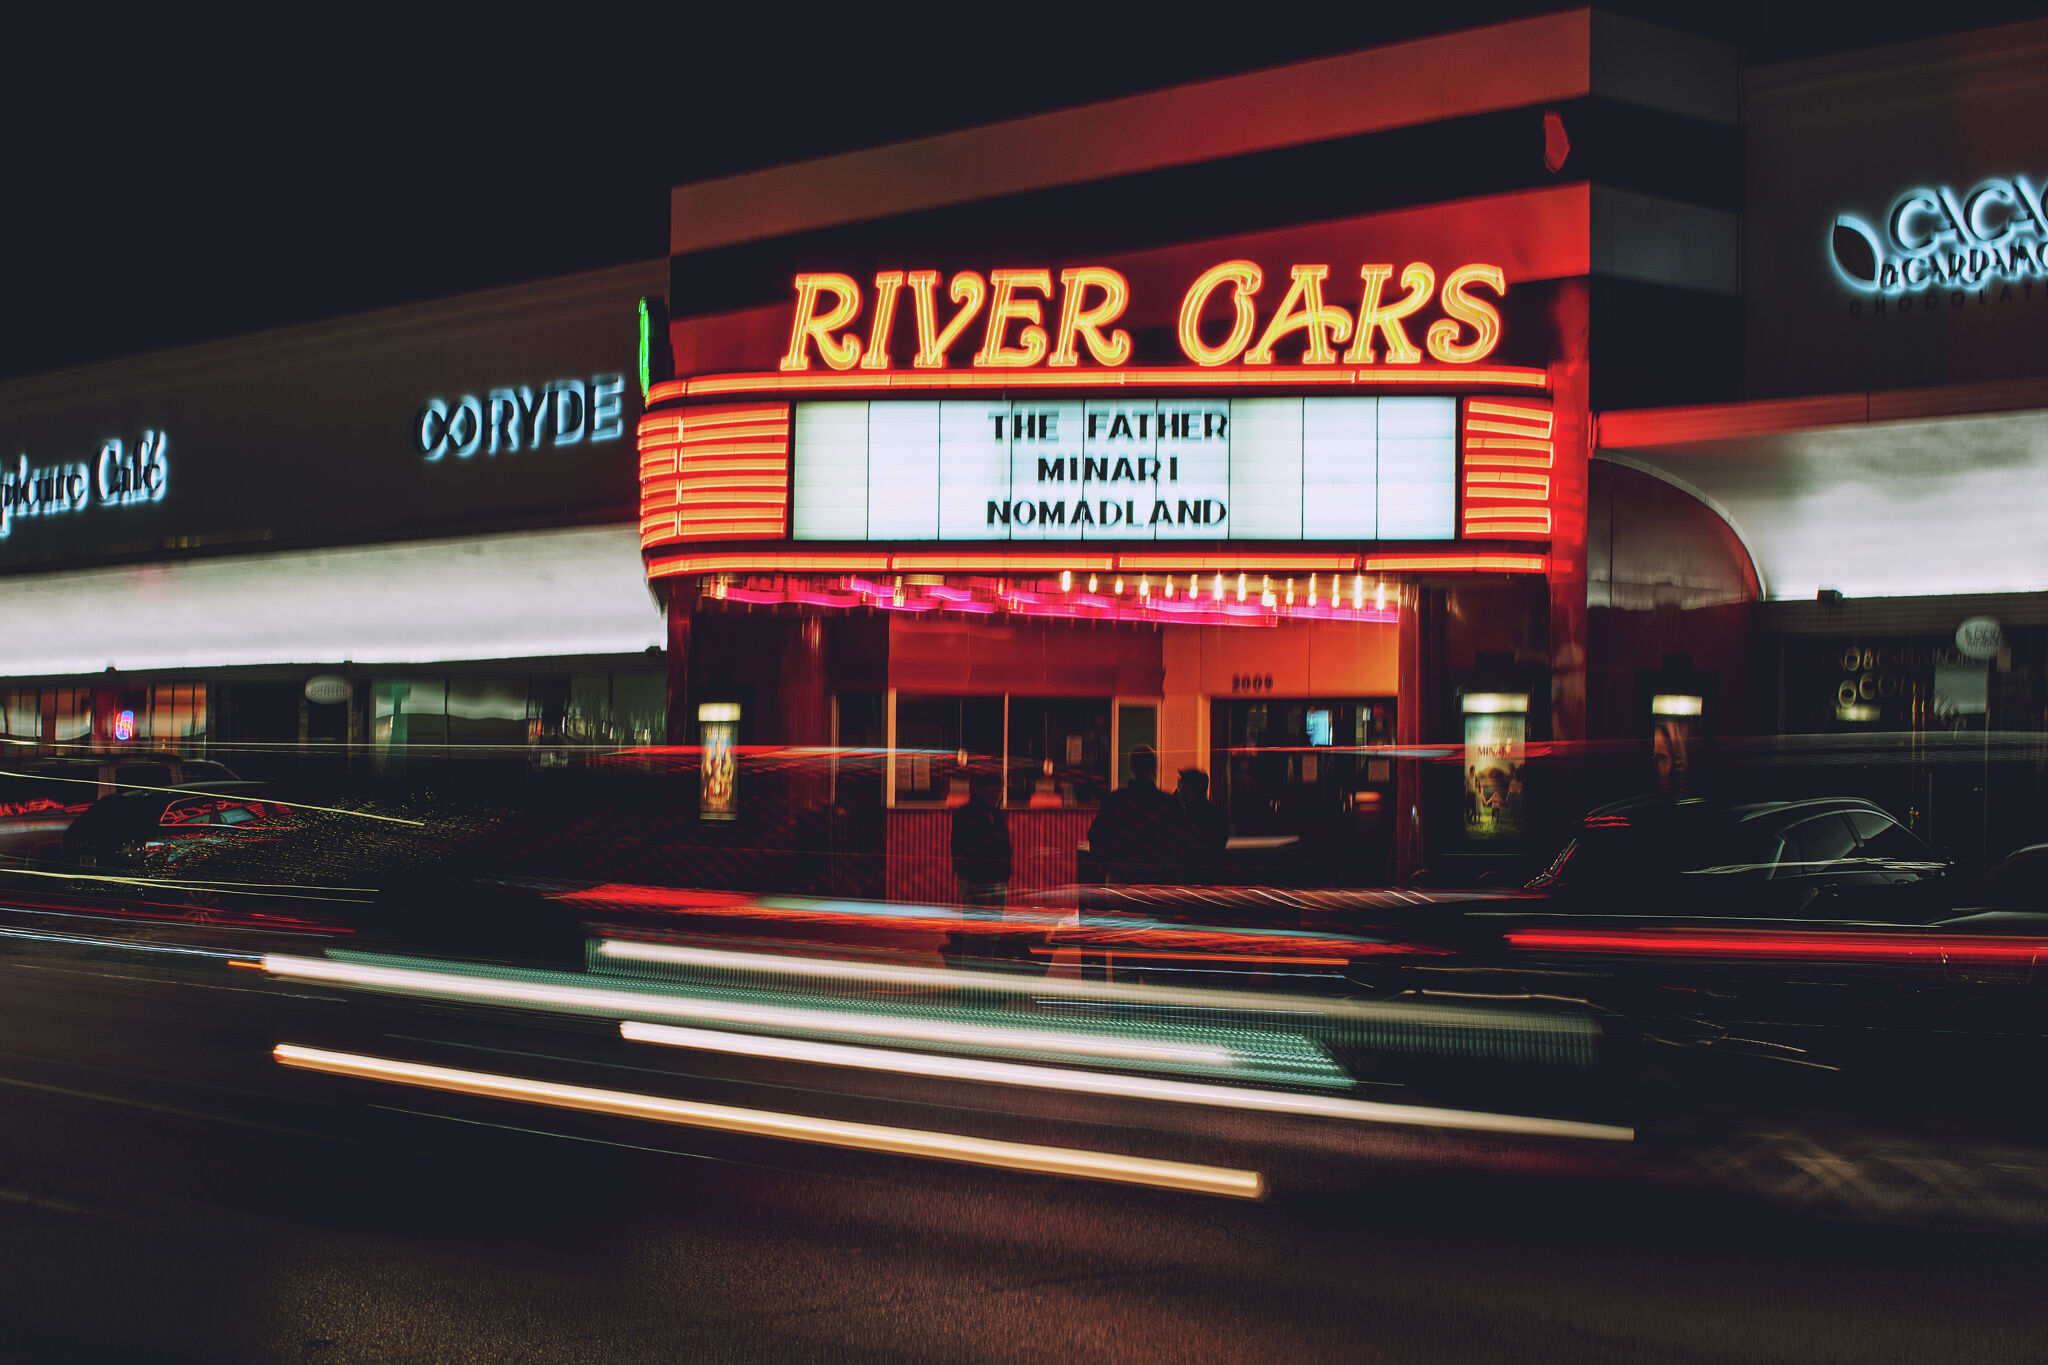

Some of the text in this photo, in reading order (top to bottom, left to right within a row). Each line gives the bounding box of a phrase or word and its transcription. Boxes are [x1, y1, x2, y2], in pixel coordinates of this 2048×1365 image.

[1889, 176, 2048, 256] CACA
[780, 260, 1505, 371] RIVER OAKS
[1849, 280, 2048, 318] CHOCOLAT
[416, 375, 624, 460] CORYDE
[987, 411, 1228, 441] THE FATHER
[0, 454, 89, 537] picure
[1037, 456, 1178, 483] MINARI
[986, 499, 1228, 526] NOMADLAND
